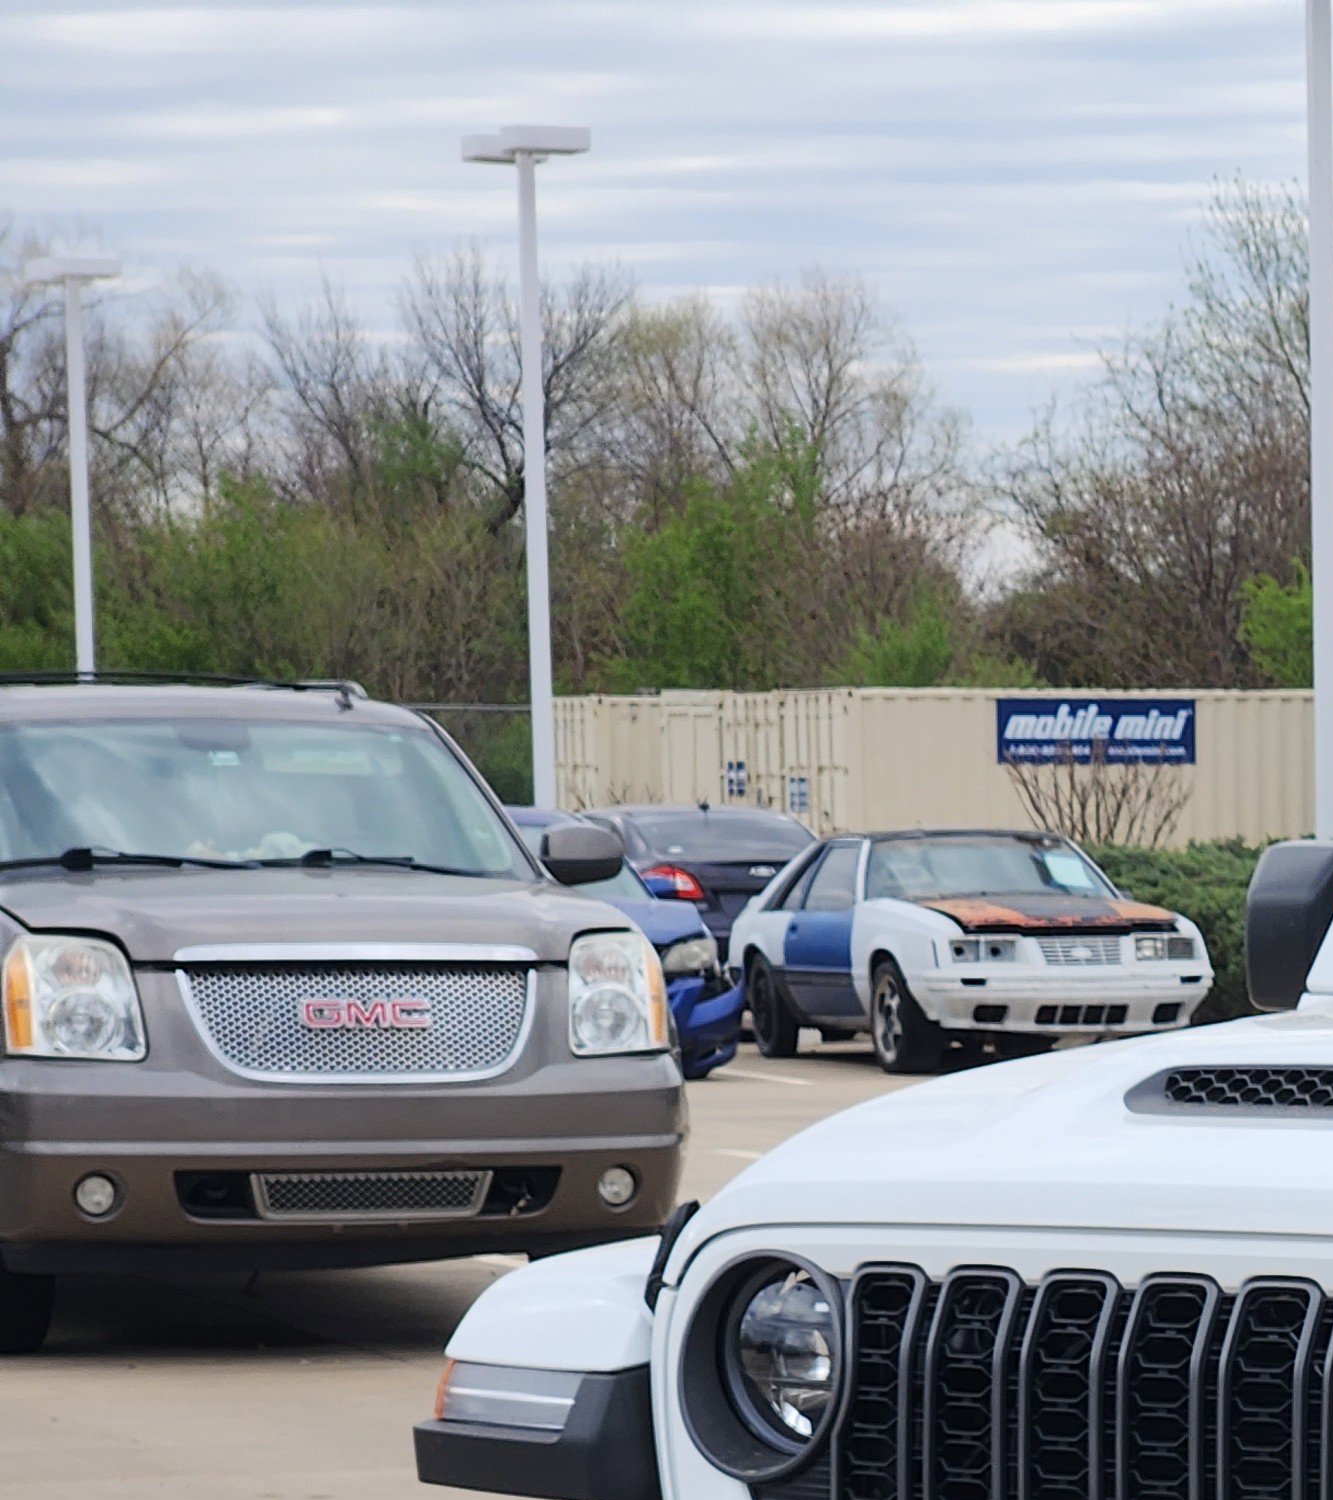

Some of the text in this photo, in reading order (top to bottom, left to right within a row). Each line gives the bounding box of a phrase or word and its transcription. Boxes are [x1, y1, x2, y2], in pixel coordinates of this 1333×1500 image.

[1004, 703, 1187, 740] mobile mini
[302, 999, 432, 1028] GMC
